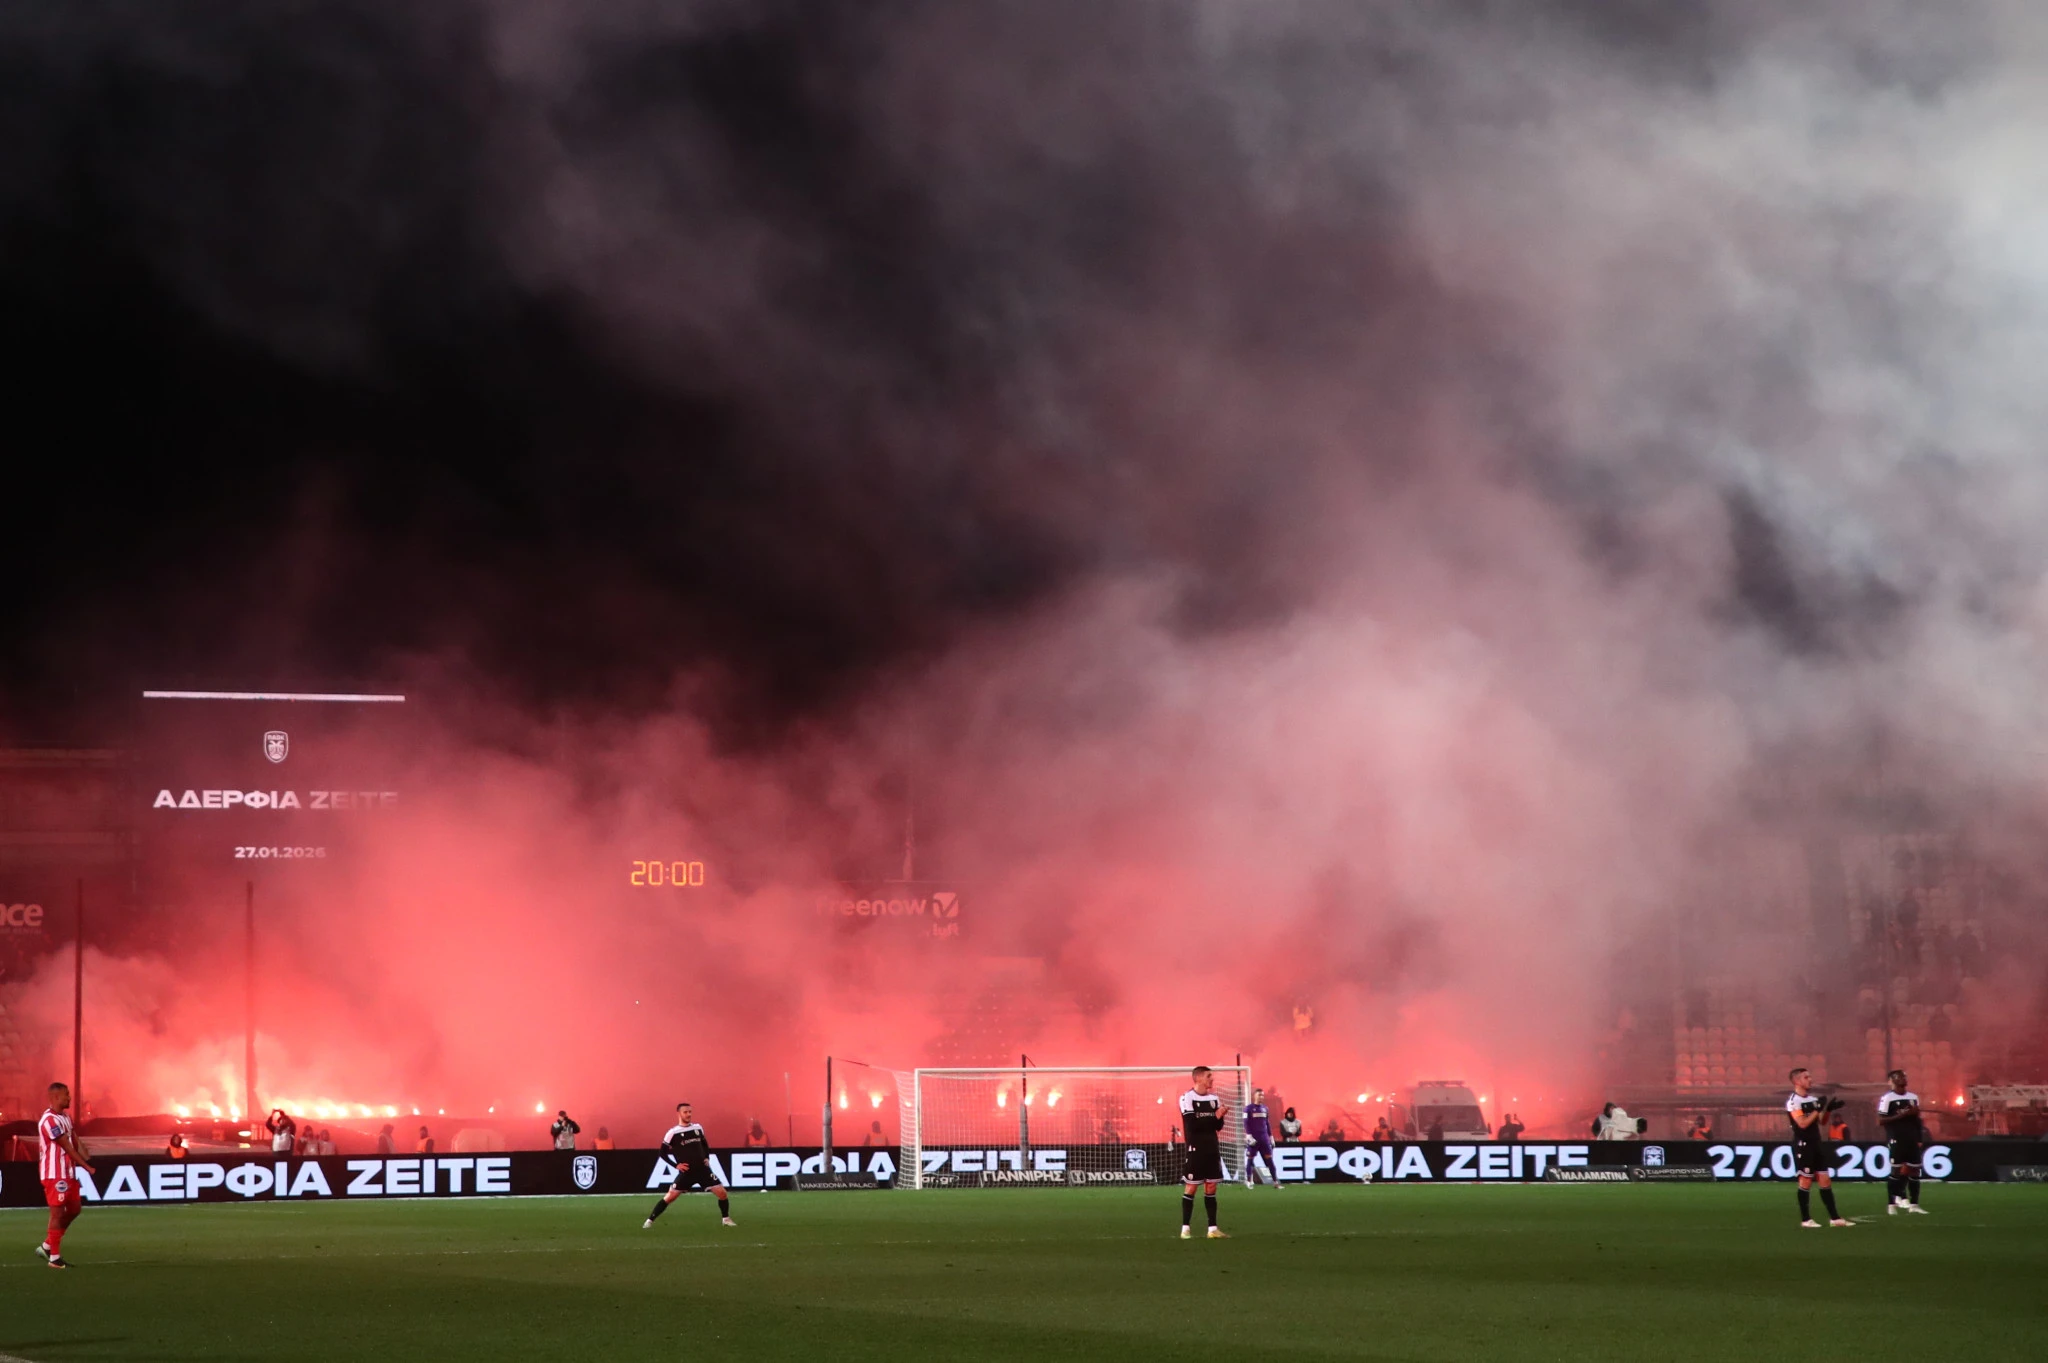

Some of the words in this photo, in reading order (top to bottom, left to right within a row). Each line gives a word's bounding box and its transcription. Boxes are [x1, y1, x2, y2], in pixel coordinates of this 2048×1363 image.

[153, 790, 301, 809] ΑΔΕΡΦΙΑ
[310, 791, 398, 809] ΖΕΙΤΕ
[235, 847, 326, 858] 27.01.2026
[631, 861, 704, 886] 20:00
[1220, 1146, 1433, 1180] ΕΡΦΙΑ
[1445, 1145, 1589, 1178] ΖΕΙΤΕ
[1707, 1145, 1952, 1178] 27.0.206
[347, 1157, 511, 1195] ΖΕΙΤΕ
[922, 1176, 954, 1185] ar.gr
[1088, 1171, 1153, 1181] MORRIS
